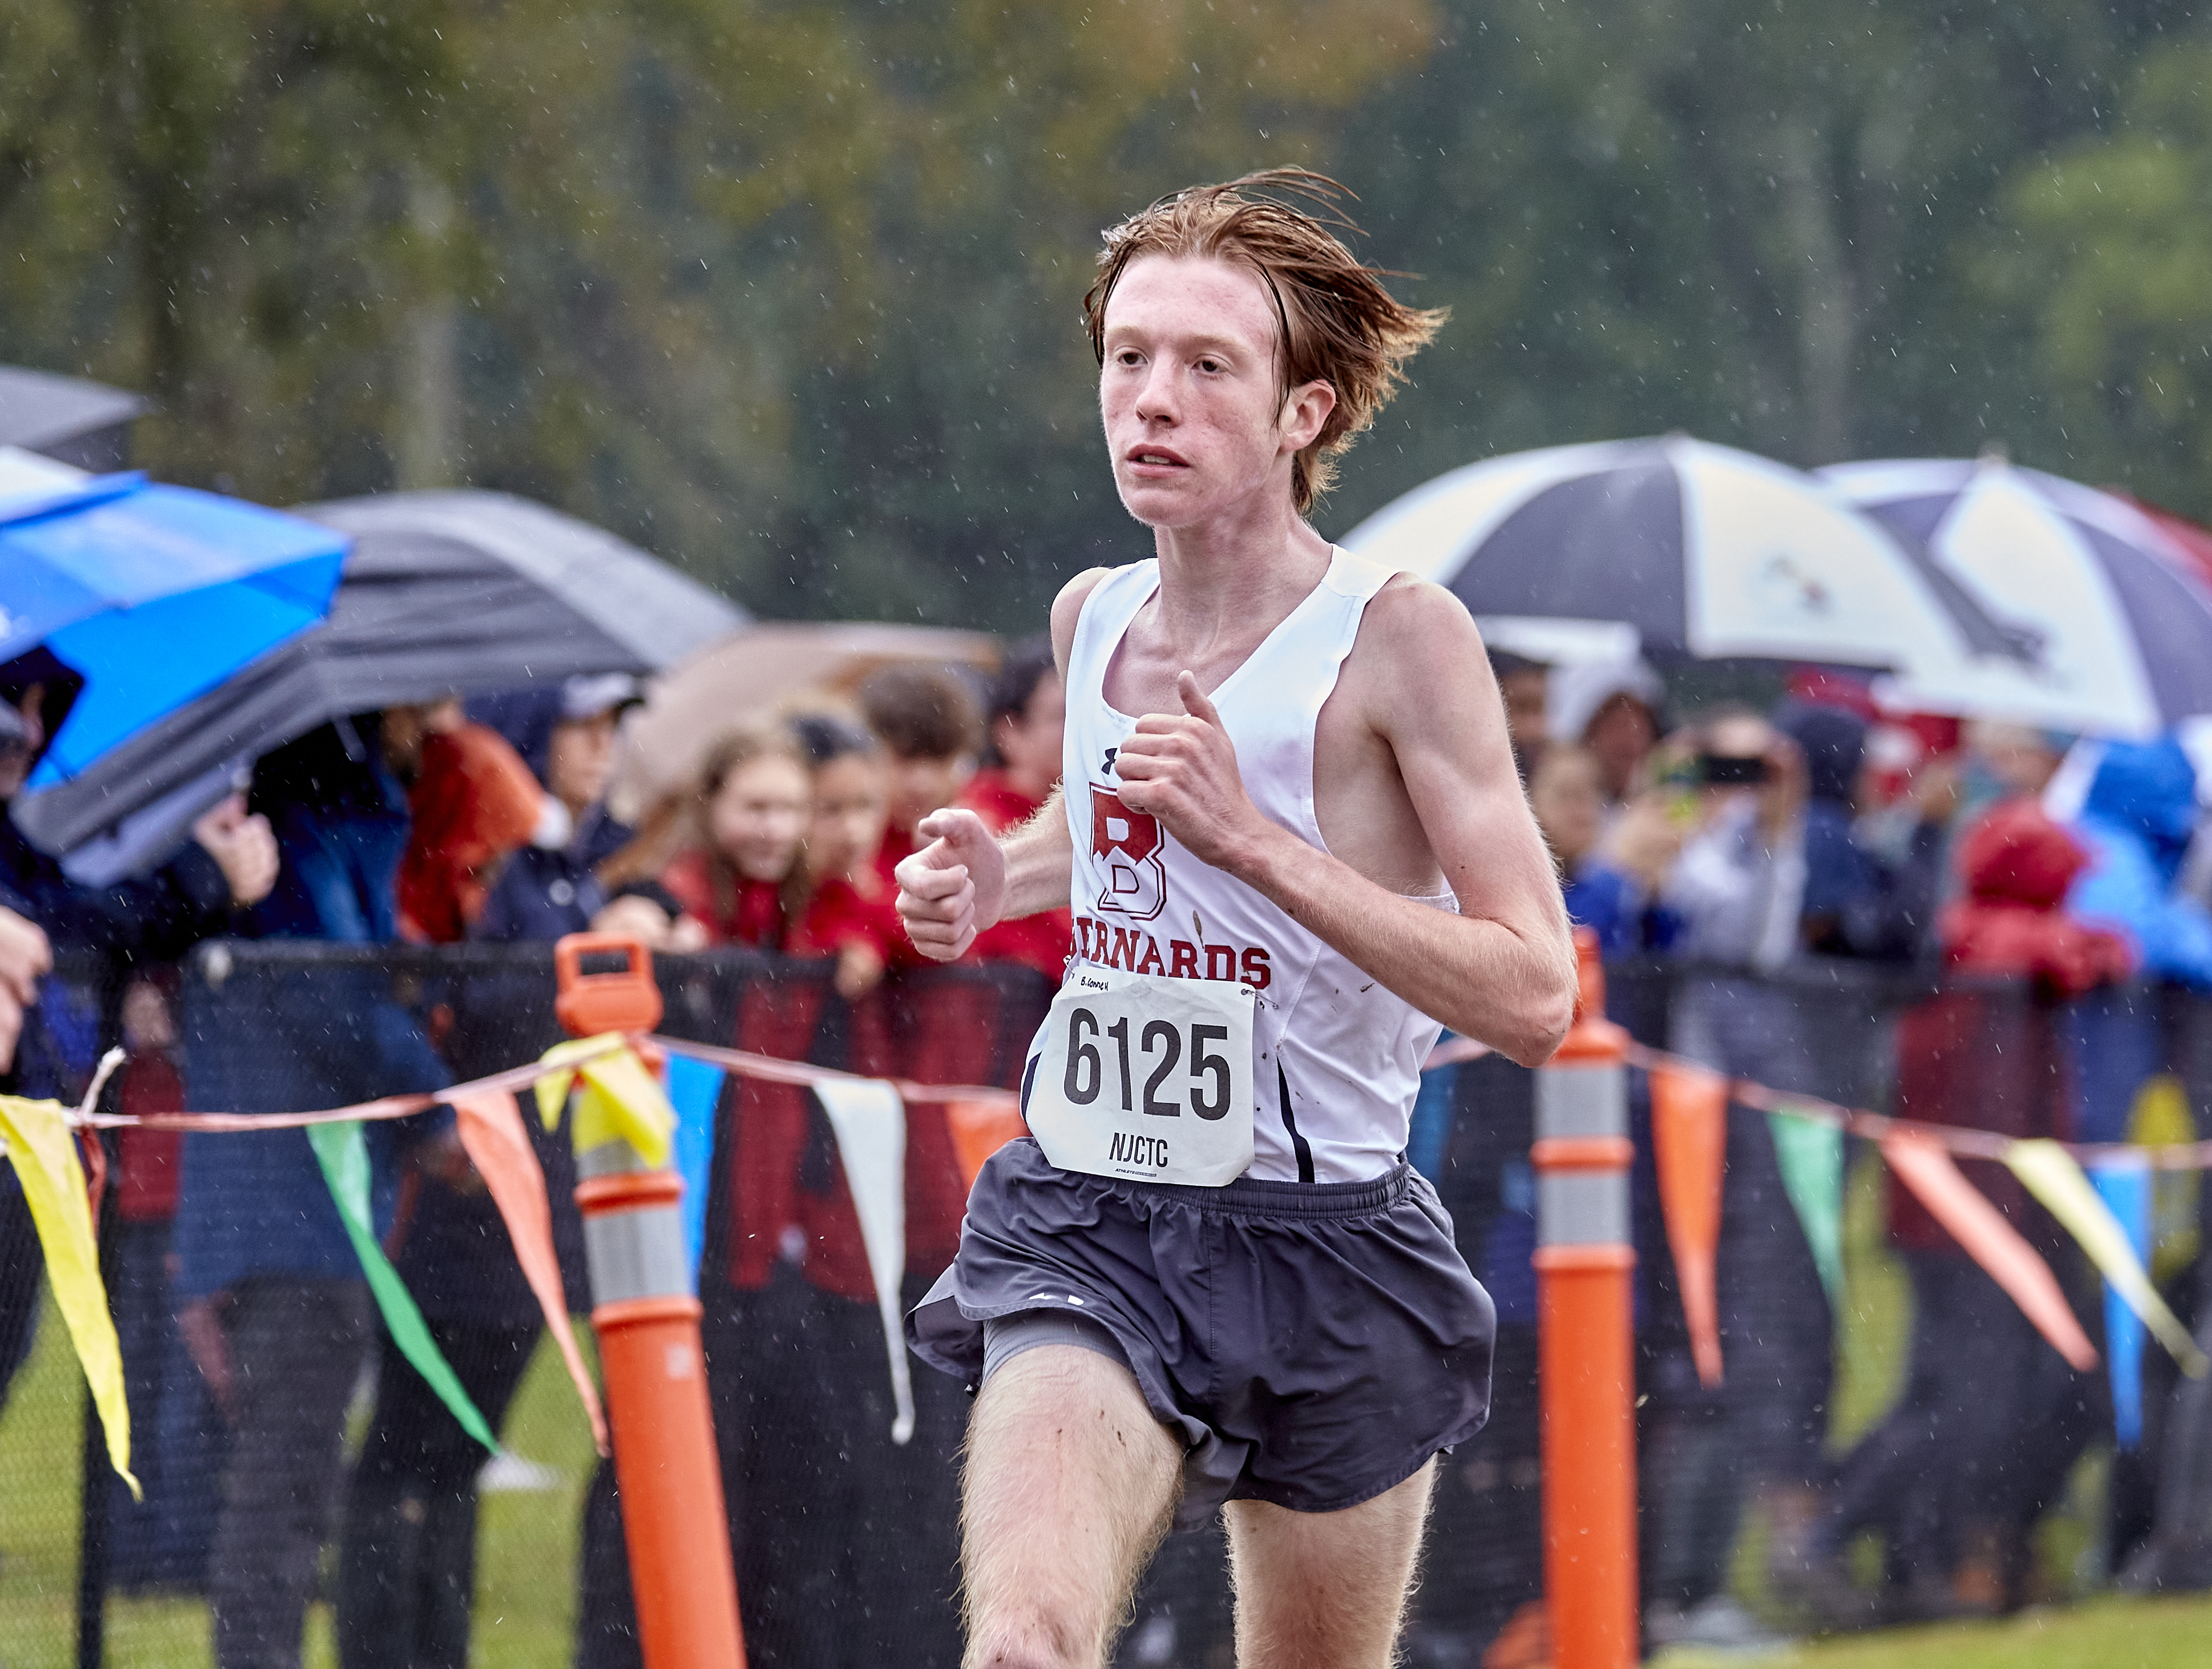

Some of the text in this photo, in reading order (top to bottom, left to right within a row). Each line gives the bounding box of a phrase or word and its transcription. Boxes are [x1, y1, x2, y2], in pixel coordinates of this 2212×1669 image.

[1089, 781, 1167, 921] B
[1063, 1007, 1232, 1121] 6125
[1109, 1132, 1168, 1168] NJCTC
